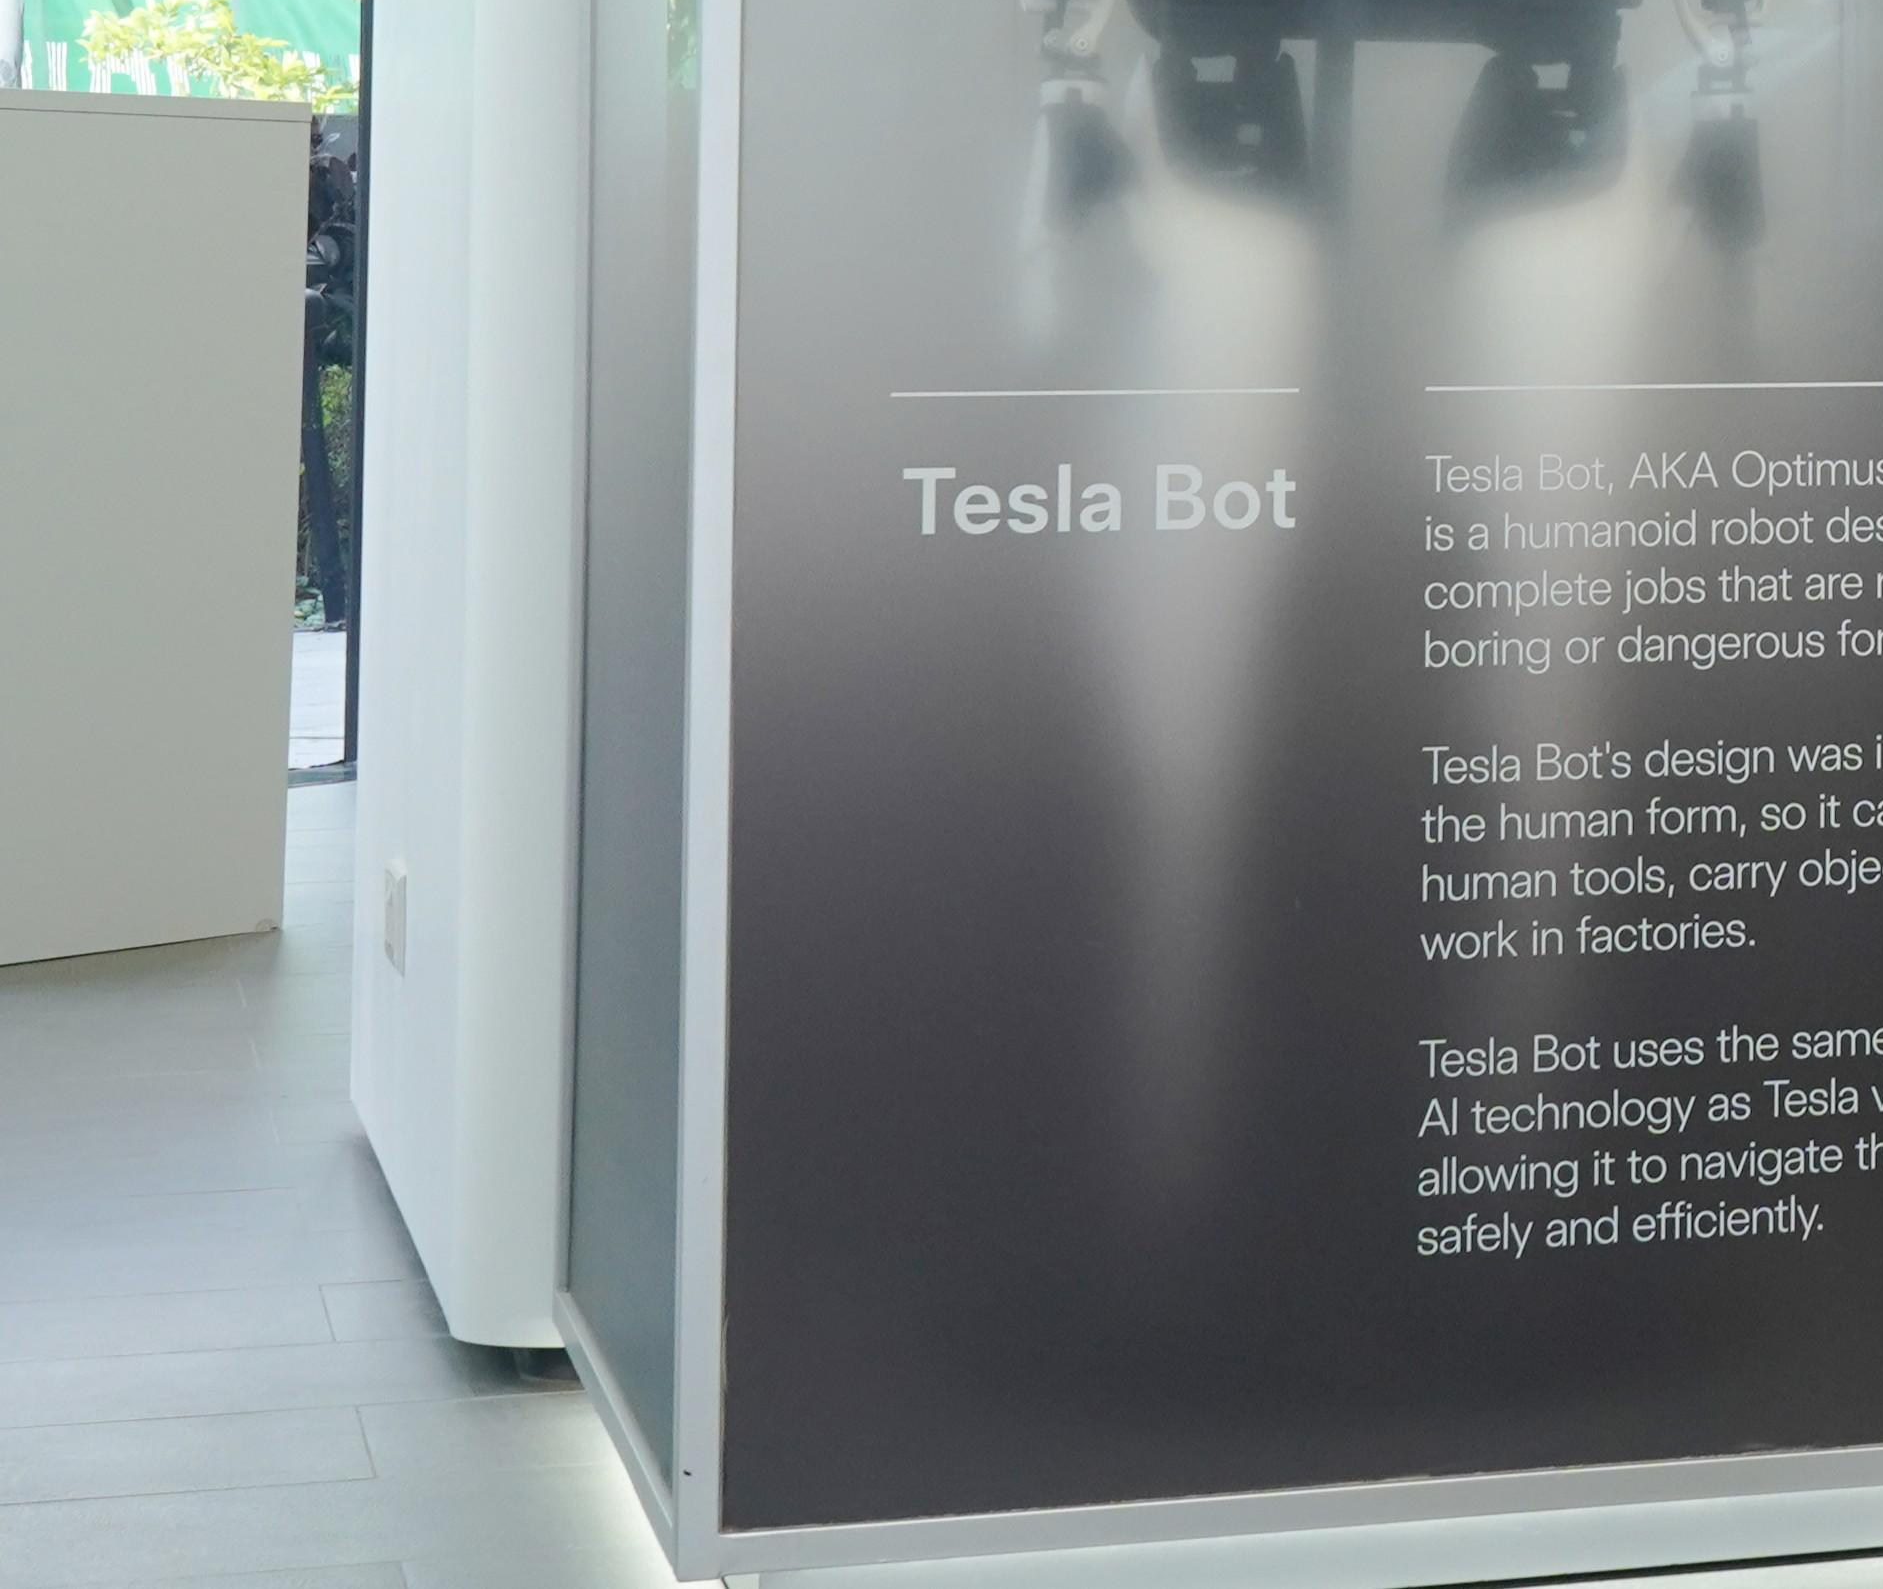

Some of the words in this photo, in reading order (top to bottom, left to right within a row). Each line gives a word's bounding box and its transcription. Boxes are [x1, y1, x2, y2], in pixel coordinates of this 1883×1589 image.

[902, 463, 1122, 536] Tesla
[1155, 464, 1297, 532] Bot
[1424, 454, 1523, 493] Tesla
[1539, 453, 1614, 499] Bot,
[1628, 450, 1719, 489] AKA
[1425, 515, 1454, 552] is
[1467, 523, 1489, 551] a
[1504, 508, 1697, 549] humanoid
[1711, 507, 1815, 546] robot
[1423, 569, 1612, 617] complete
[1622, 566, 1706, 615] jobs
[1717, 564, 1793, 603] that
[1804, 572, 1864, 601] are
[1424, 629, 1551, 675] boring
[1564, 636, 1606, 665] or
[1617, 624, 1826, 671] dangerous
[1421, 744, 1521, 785] Tesla
[1536, 740, 1632, 781] Bot's
[1644, 738, 1775, 785] design
[1787, 743, 1863, 773] was
[1420, 804, 1486, 844] the
[1499, 802, 1634, 841] human
[1645, 796, 1746, 838] form,
[1760, 802, 1807, 831] so
[1819, 793, 1841, 829] it
[1422, 863, 1557, 903] human
[1569, 855, 1675, 899] tools,
[1689, 860, 1788, 898] carry
[1419, 919, 1518, 961] work
[1532, 920, 1564, 956] in
[1575, 913, 1756, 954] factories.
[1418, 1036, 1518, 1079] Tesla
[1533, 1033, 1602, 1073] Bot
[1613, 1036, 1705, 1069] uses
[1715, 1024, 1780, 1063] the
[1417, 1097, 1458, 1138] AI
[1470, 1088, 1696, 1135] technology
[1707, 1092, 1752, 1122] as
[1762, 1076, 1859, 1118] Tesla
[1417, 1154, 1579, 1198] allowing
[1593, 1149, 1616, 1186] it
[1626, 1149, 1668, 1184] to
[1680, 1139, 1844, 1186] navigate
[1417, 1211, 1534, 1260] safely
[1545, 1205, 1619, 1248] and
[1632, 1194, 1824, 1243] efficiently.
